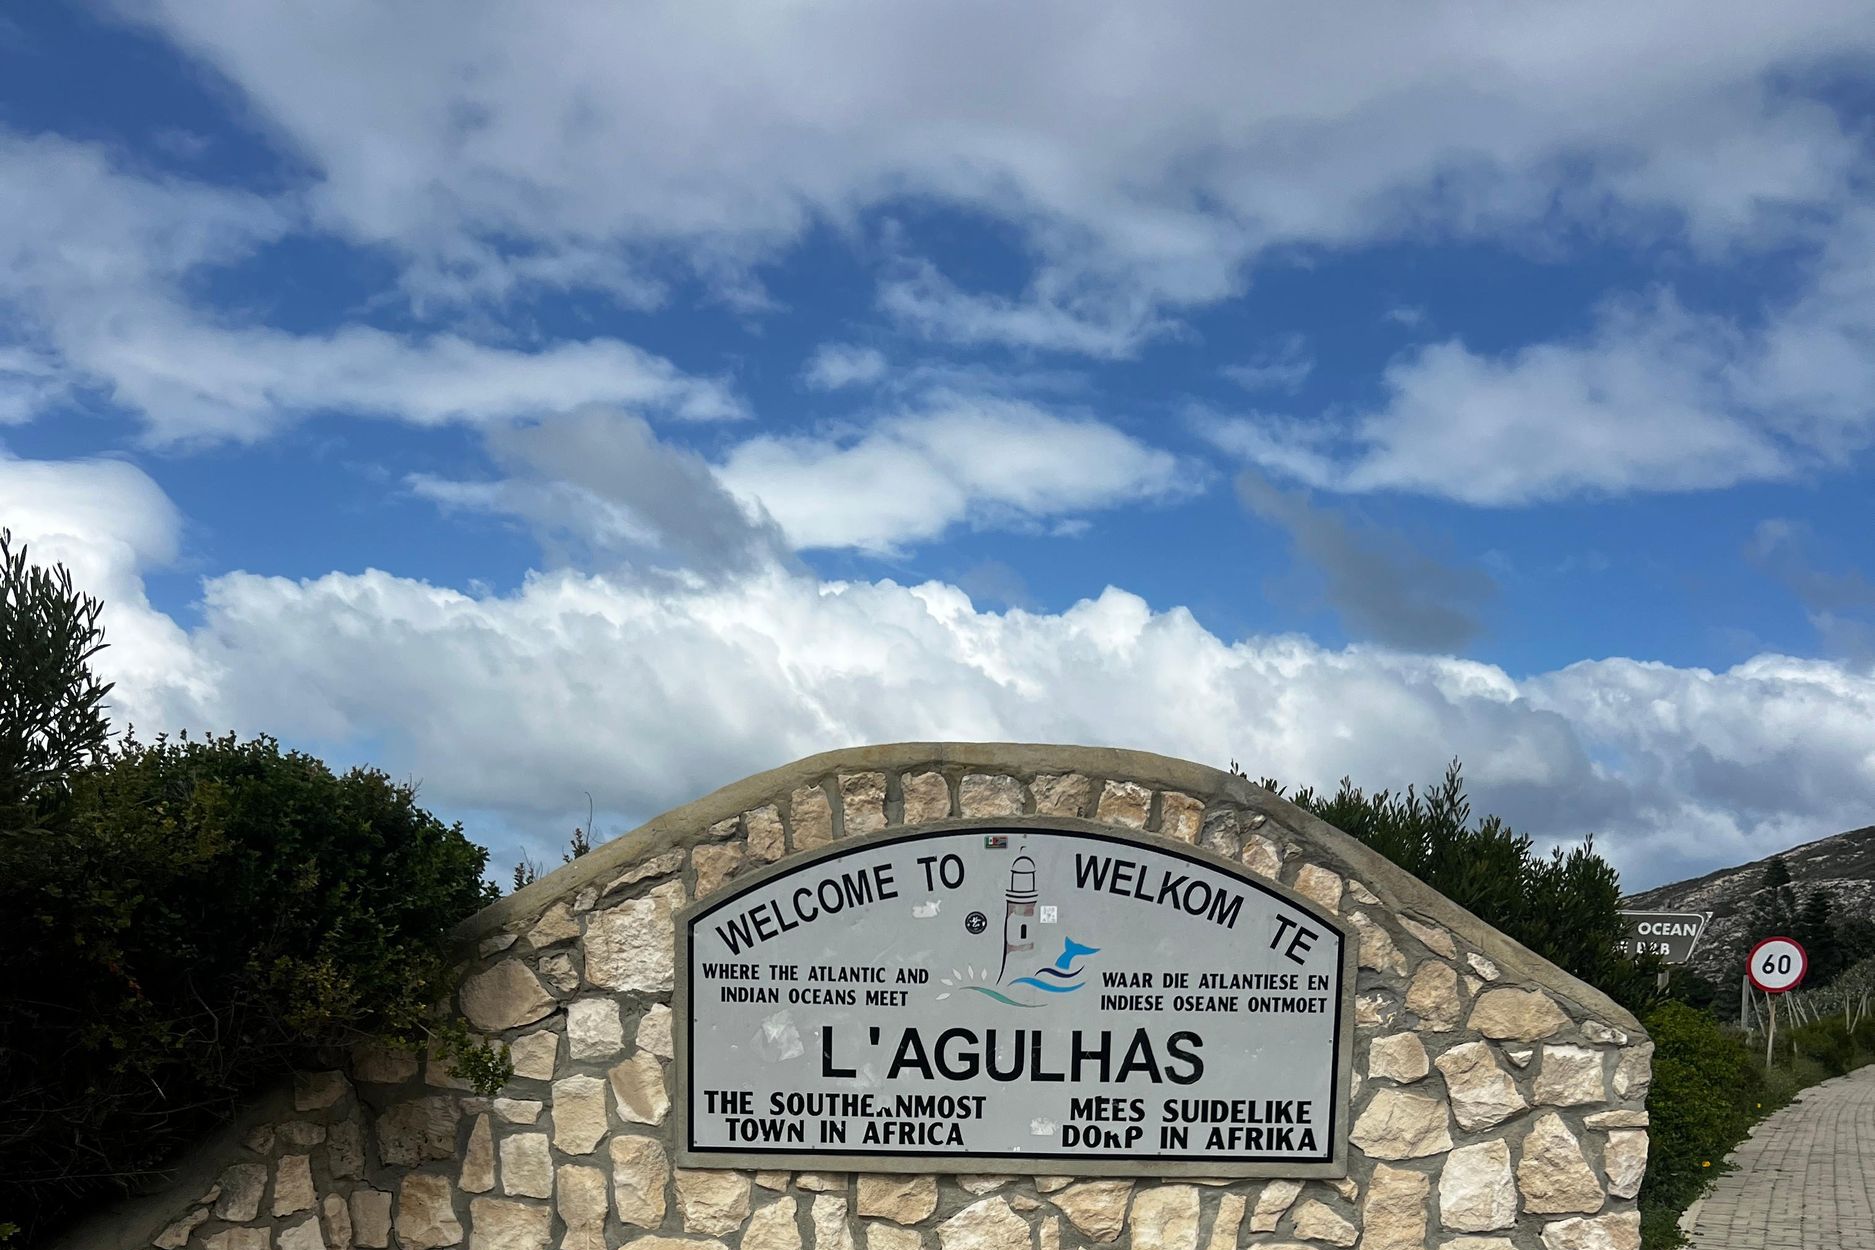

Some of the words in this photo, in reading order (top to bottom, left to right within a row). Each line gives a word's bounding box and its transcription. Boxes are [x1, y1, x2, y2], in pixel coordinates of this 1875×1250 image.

[714, 863, 899, 956] WELCOME
[916, 853, 965, 892] TO
[1075, 853, 1245, 930] WELKOM
[1269, 913, 1320, 966] TE
[1637, 922, 1697, 936] OCEAN
[702, 962, 760, 981] WHERE
[769, 964, 799, 981] THE
[807, 965, 886, 984] ATLANTIC
[895, 967, 929, 984] AND
[1762, 954, 1791, 975] 60
[1102, 971, 1153, 989] WAAR
[1162, 972, 1189, 989] DIE
[1198, 973, 1299, 991] ATLANTIESE
[1307, 974, 1329, 991] EN
[720, 986, 780, 1004] INDIAN
[788, 988, 857, 1006] OCEANS
[865, 990, 909, 1007] MEET
[1100, 994, 1164, 1012] INDIESE
[1173, 995, 1239, 1013] OSEANE
[1247, 996, 1328, 1014] ONTMOET
[822, 1026, 1205, 1085] L'AGULHAS
[704, 1090, 754, 1115] THE
[1070, 1096, 1146, 1122] MEES
[1162, 1099, 1312, 1124] SUIDELIKE
[725, 1117, 805, 1143] TOWN
[820, 1119, 847, 1144] IN
[862, 1121, 965, 1146] AFRICA
[1159, 1126, 1189, 1150] IN
[1204, 1126, 1318, 1152] AFRIKA
